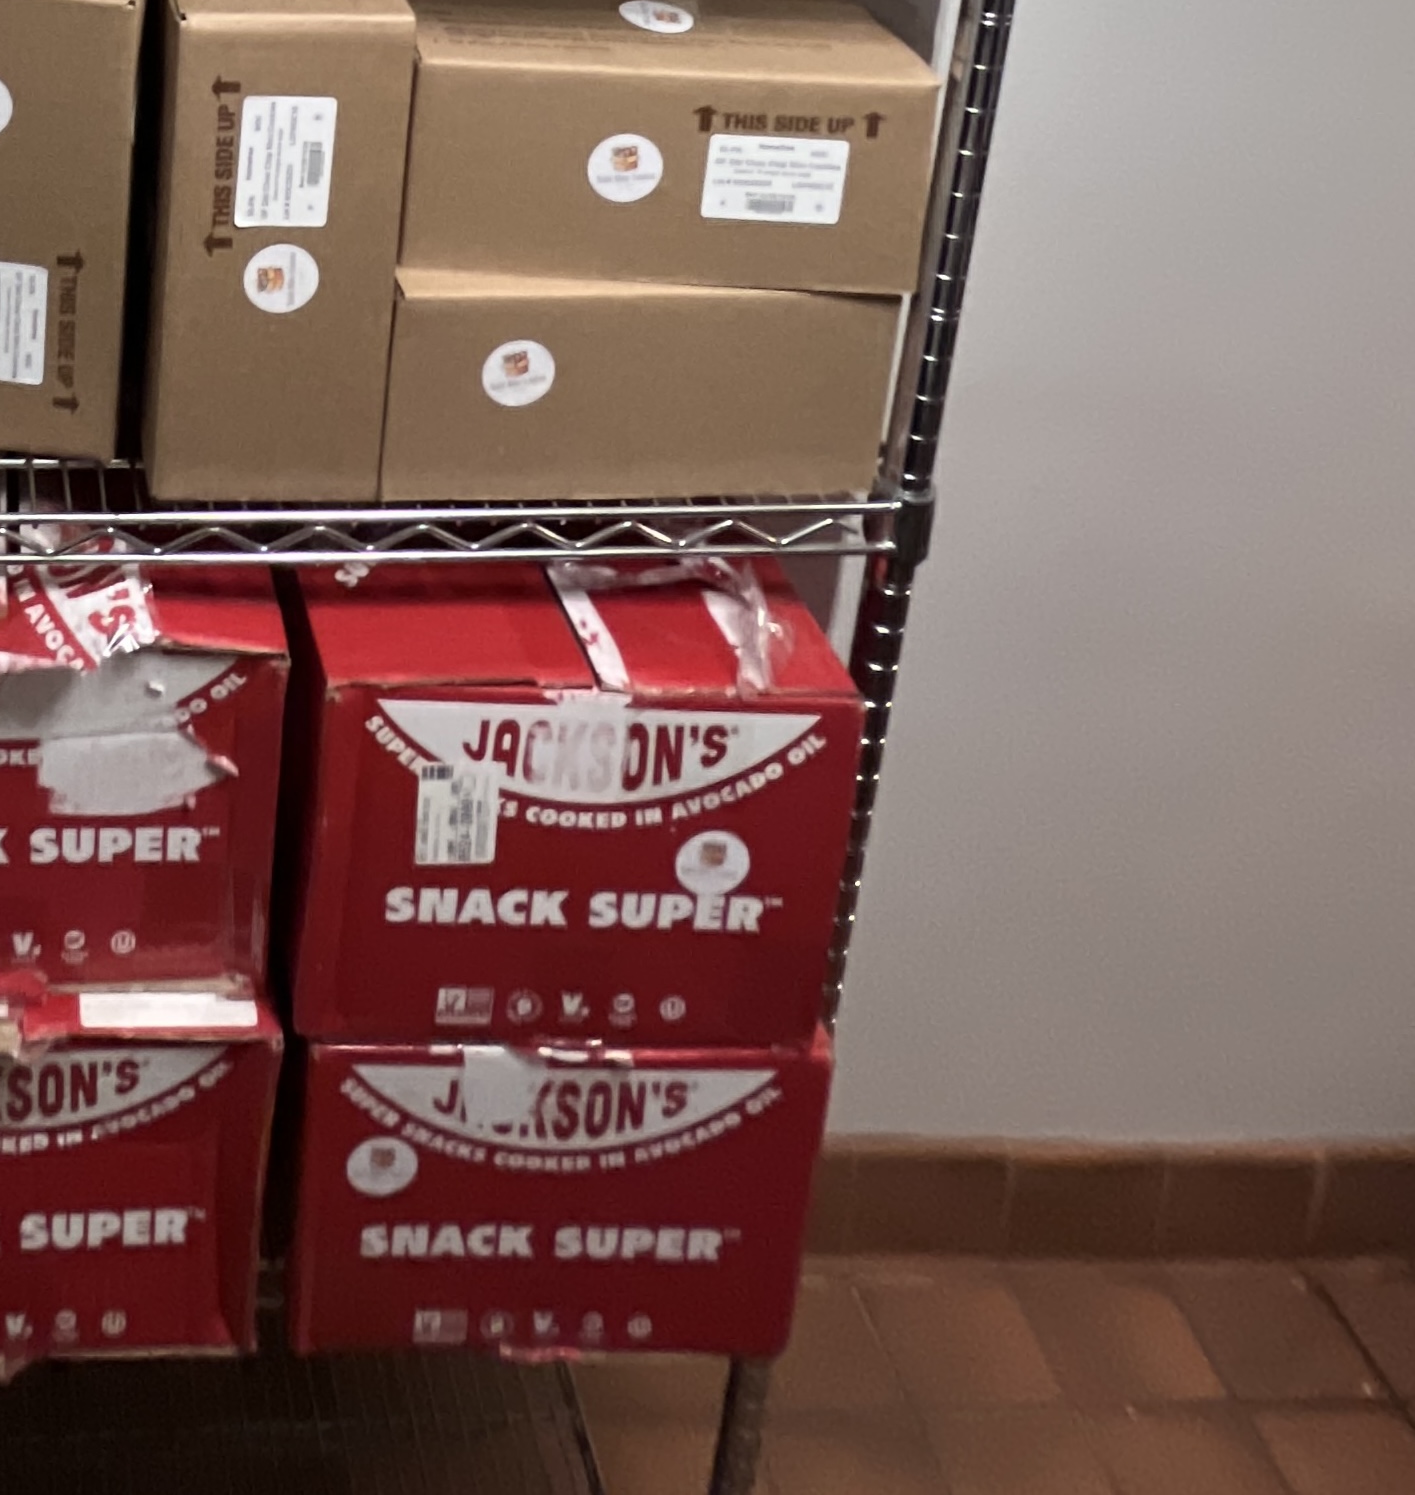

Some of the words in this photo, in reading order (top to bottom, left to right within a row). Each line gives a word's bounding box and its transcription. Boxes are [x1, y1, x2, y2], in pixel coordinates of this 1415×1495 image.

[217, 103, 236, 132] UP
[722, 112, 768, 131] THIS
[773, 114, 821, 133] SIDE
[827, 117, 856, 134] UP
[214, 135, 234, 180] SIDE
[212, 186, 232, 227] THIS
[57, 318, 77, 361] SIDE
[56, 363, 76, 389] UP
[209, 672, 247, 700] OIL
[462, 717, 730, 792] JACKSON'S
[525, 806, 627, 829] COOKED
[634, 806, 664, 827] IN
[671, 760, 784, 821] AVOCADO
[788, 732, 827, 767] OIL
[384, 886, 570, 930] SNACK
[339, 1076, 402, 1129] SUPER
[400, 1122, 487, 1164] SNACKS
[493, 1151, 592, 1173] COOKED
[599, 1151, 627, 1169] IN
[633, 1111, 743, 1165] AVOCADO
[359, 1223, 534, 1262] SNACK
